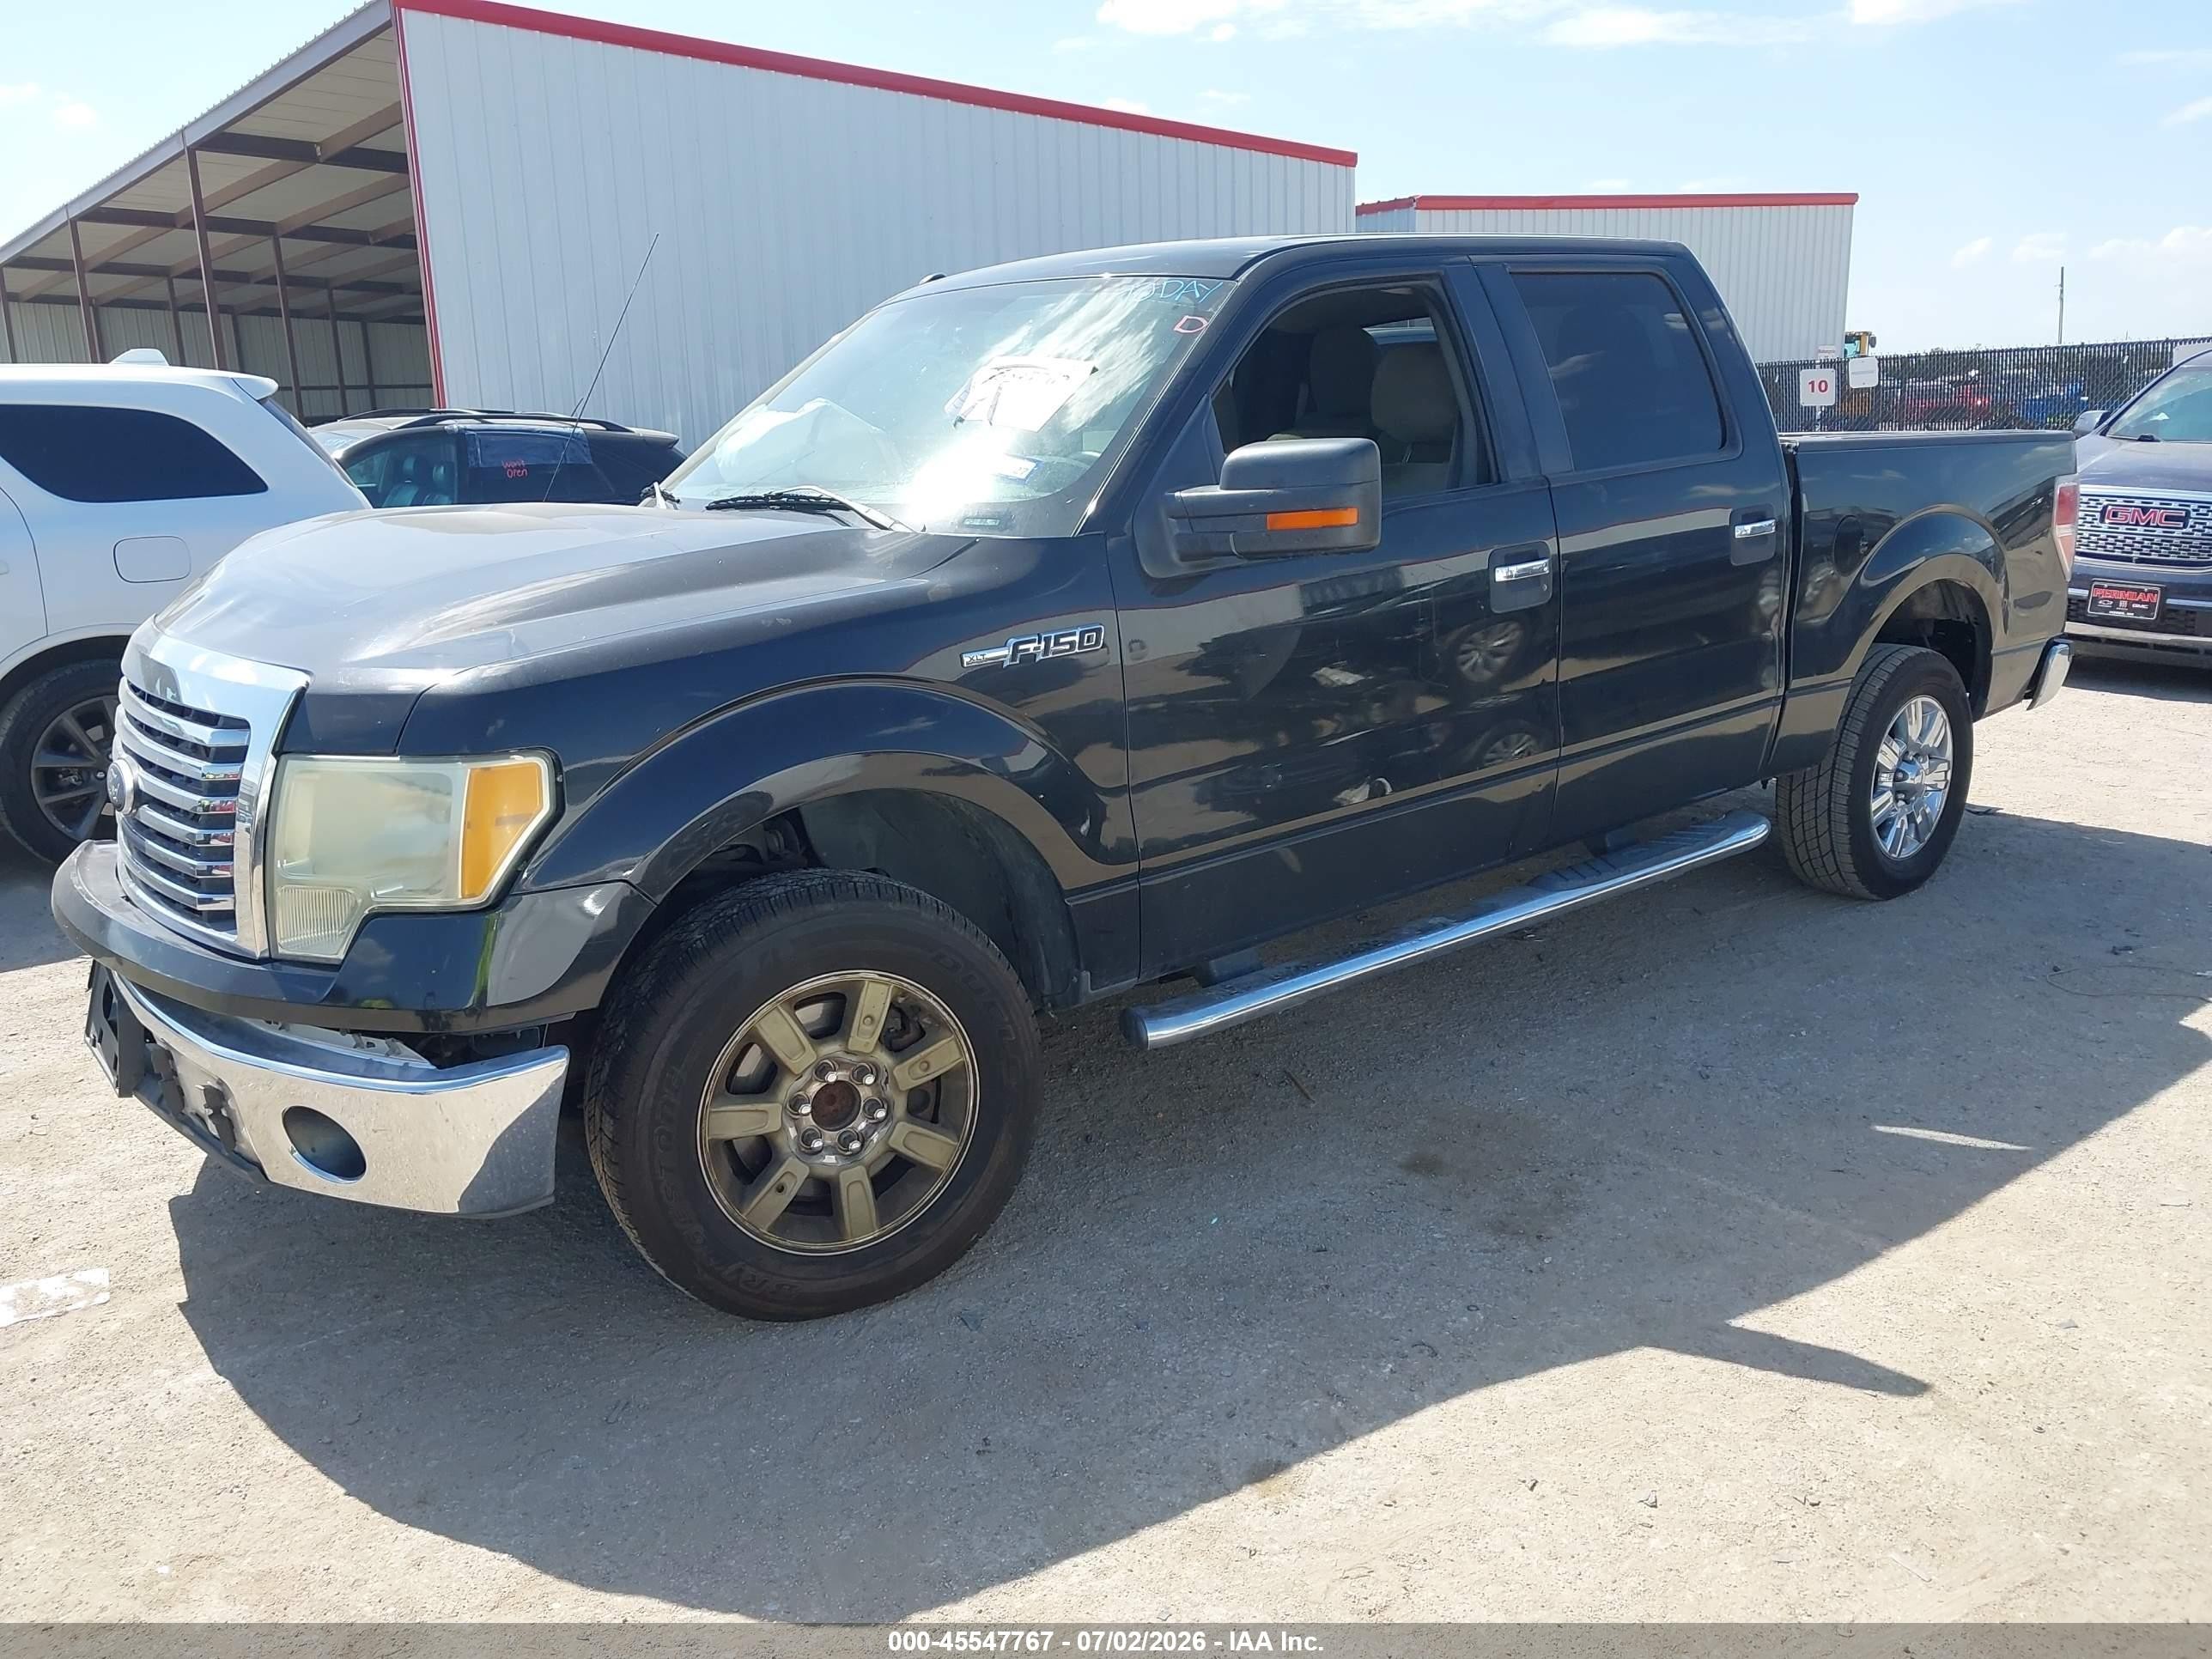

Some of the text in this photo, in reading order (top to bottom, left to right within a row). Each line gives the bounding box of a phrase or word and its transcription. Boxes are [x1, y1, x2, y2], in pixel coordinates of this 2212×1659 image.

[1173, 314, 1208, 333] D
[1808, 380, 1829, 392] 10
[2106, 506, 2185, 527] GMC
[2094, 588, 2157, 602] PERMIAN
[967, 653, 988, 663] XLT
